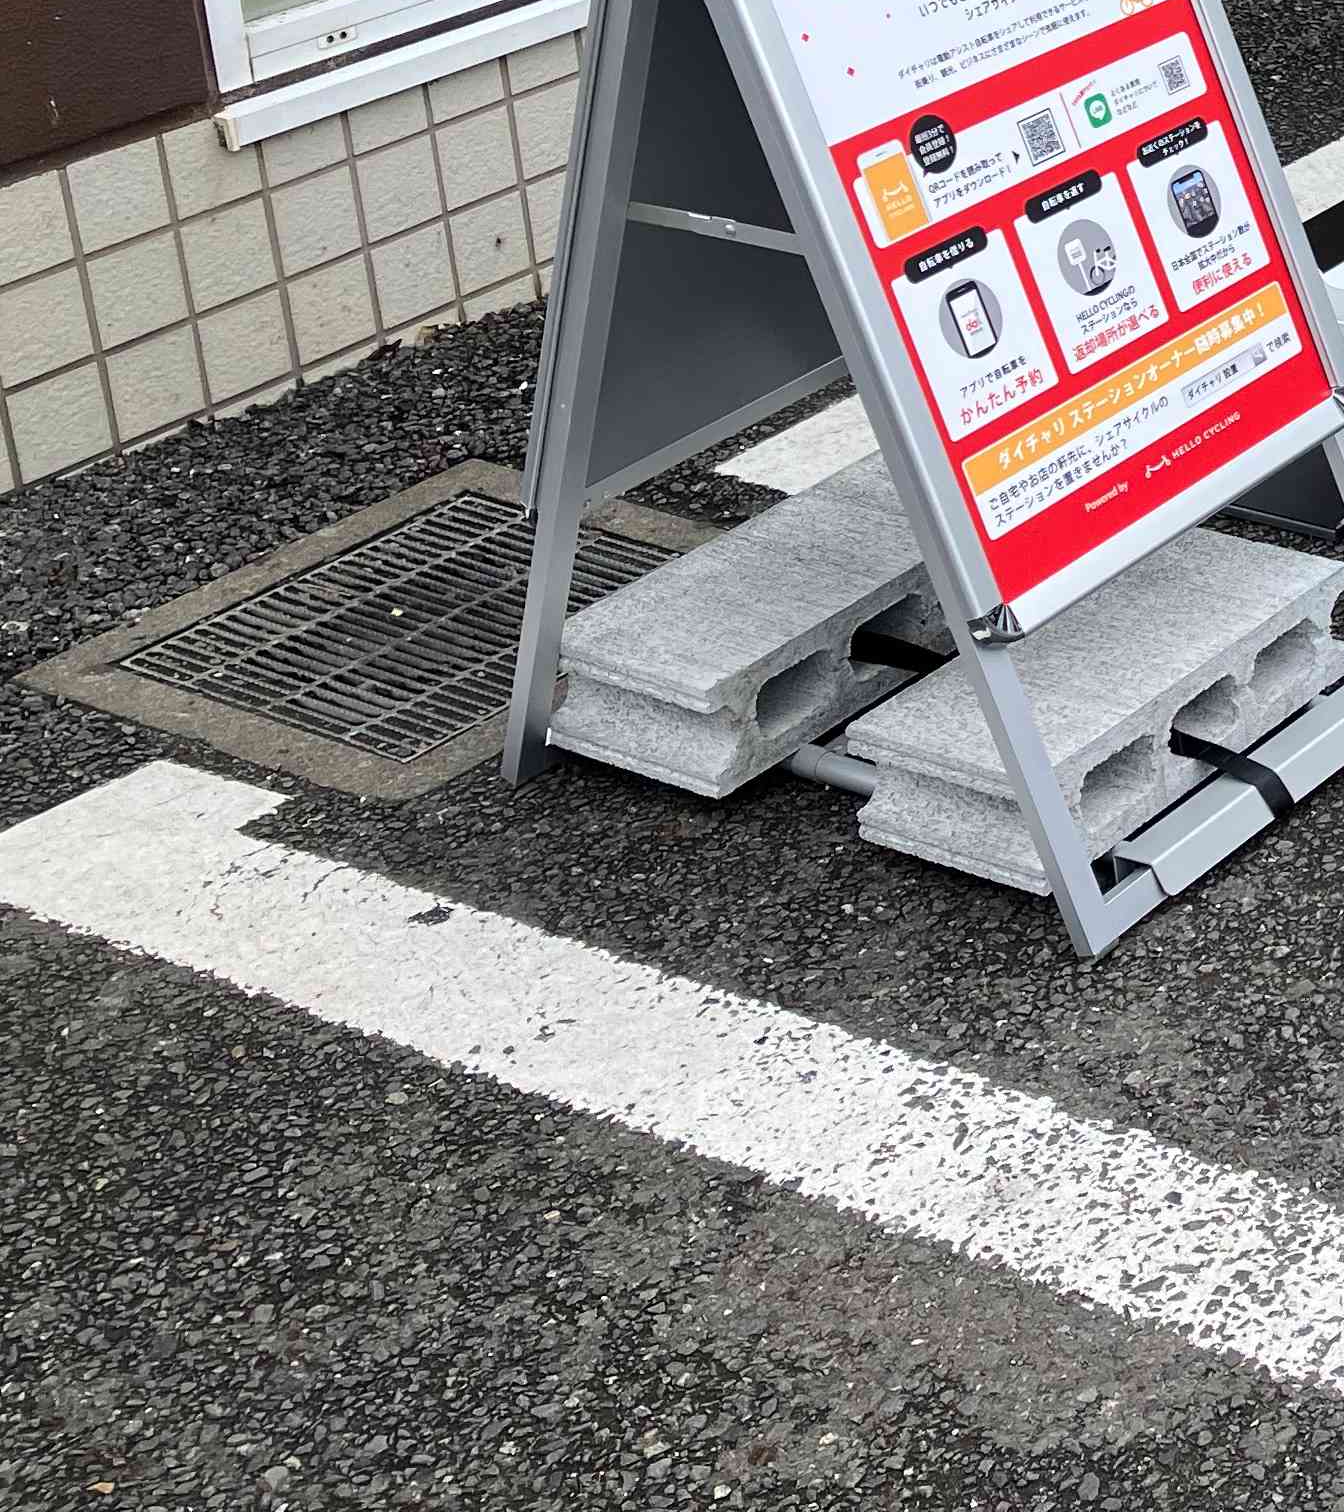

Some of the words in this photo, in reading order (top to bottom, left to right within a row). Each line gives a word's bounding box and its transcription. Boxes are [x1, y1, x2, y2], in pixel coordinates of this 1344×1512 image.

[917, 236, 974, 272] 自転車を借りる
[1191, 251, 1253, 295] 便利に使える
[1072, 302, 1160, 362] 返却場所が選べる
[1075, 303, 1099, 323] HELLO
[1080, 297, 1138, 335] ステーションなら
[1265, 330, 1291, 354] で検索
[958, 366, 1044, 426] かんたん予約
[959, 353, 1027, 398] アプリで自転車を
[1186, 372, 1223, 401] ダイチャリ
[987, 393, 1170, 512] ご自宅やお店の軒先に、シェアサイクルの
[995, 415, 1067, 471] ダイチャリ
[1170, 434, 1202, 460] HELLO
[1201, 409, 1242, 441] CYCLING
[993, 436, 1129, 528] ステーションを置きませんか？
[1084, 484, 1119, 514] Powered
[1116, 478, 1130, 496] by
